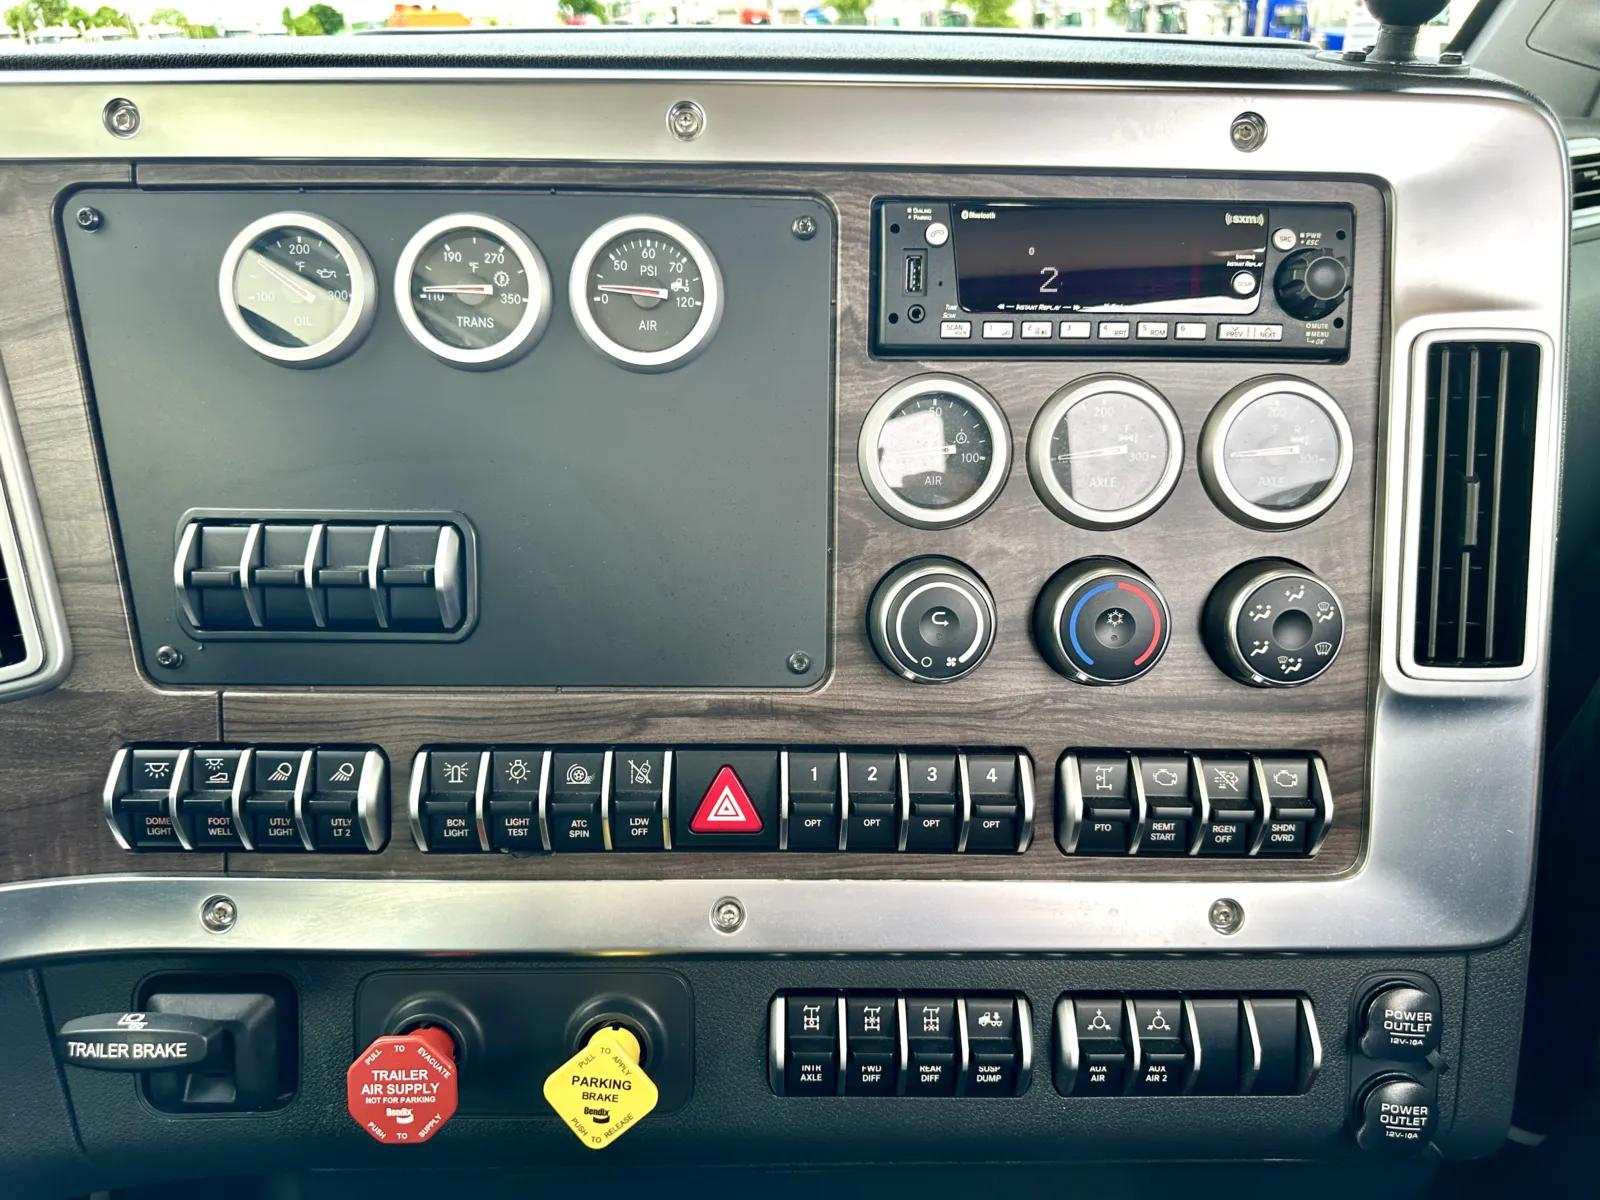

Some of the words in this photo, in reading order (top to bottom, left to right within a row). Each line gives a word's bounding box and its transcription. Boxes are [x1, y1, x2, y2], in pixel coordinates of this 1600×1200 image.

[969, 211, 996, 219] Bluetooth
[289, 244, 310, 255] 200
[641, 248, 656, 259] 60
[443, 252, 462, 263] 190
[484, 253, 505, 264] 270
[613, 260, 628, 271] 50
[669, 262, 683, 273] 70
[640, 265, 658, 277] PSI
[1039, 266, 1059, 293] 2
[328, 290, 348, 301] 300
[500, 294, 521, 305] 350
[601, 293, 609, 304] 0
[676, 297, 695, 308] 120
[294, 316, 312, 327] OIL
[456, 315, 494, 328] TRANS
[639, 320, 657, 331] AIR
[961, 452, 979, 463] 100
[1128, 451, 1149, 462] 300
[924, 475, 943, 486] AIR
[1089, 476, 1117, 488] AXLE
[810, 767, 817, 781] 1
[867, 766, 877, 781] 2
[927, 767, 938, 782] 3
[986, 768, 998, 783] 4
[145, 817, 171, 826] DOME
[208, 817, 230, 826] FOOT
[269, 818, 291, 826] UTLY
[331, 818, 352, 827] UTLY
[446, 818, 465, 827] BCN
[505, 818, 530, 826] LIGHT
[571, 819, 588, 828] ATC
[629, 818, 650, 826] LDW
[804, 819, 822, 827] OPT
[863, 818, 880, 827] OPT
[922, 819, 940, 828] OPT
[982, 820, 1000, 829] OPT
[1094, 824, 1112, 832] PTO
[1152, 822, 1176, 831] REMT
[1212, 825, 1236, 834] RGEN
[1271, 824, 1296, 832] SHDN
[146, 827, 172, 836] LIGHT
[208, 827, 232, 836] WELL
[269, 827, 294, 836] LIGHT
[333, 828, 344, 837] LT
[345, 829, 351, 837] 2
[444, 829, 469, 837] LIGHT
[507, 828, 528, 837] TEST
[569, 829, 590, 838] SPIN
[631, 827, 648, 836] OFF
[1150, 832, 1176, 841] START
[1214, 835, 1232, 843] OFF
[1271, 833, 1295, 842] OVRD
[1384, 1009, 1432, 1022] POWER
[1383, 1020, 1432, 1032] OUTLET
[68, 1041, 129, 1058] TRAILER
[133, 1042, 188, 1058] BRAKE
[365, 1049, 382, 1066] PULL
[394, 1044, 405, 1053] TO
[417, 1047, 451, 1079] EVACUATE
[578, 1054, 597, 1069] PULL
[600, 1047, 611, 1055] TO
[612, 1055, 632, 1077] APPLY
[861, 1065, 882, 1073] FWD
[919, 1065, 942, 1073] REAR
[978, 1065, 1001, 1073] SUSP
[1089, 1065, 1107, 1073] AUX
[1148, 1065, 1166, 1073] AUX
[371, 1069, 429, 1081] TRAILER
[800, 1073, 823, 1082] AXLE
[862, 1074, 881, 1082] DIFF
[921, 1074, 940, 1082] DIFF
[976, 1074, 1002, 1083] DUMP
[1090, 1074, 1105, 1082] AIR
[1145, 1074, 1160, 1082] AIR
[1162, 1074, 1168, 1082] 2
[571, 1075, 632, 1091] PARKING
[361, 1084, 384, 1095] AIR
[386, 1082, 440, 1095] SUPPLY
[365, 1097, 381, 1105] NOT
[383, 1096, 399, 1104] FOR
[400, 1095, 436, 1104] PARKING
[581, 1091, 619, 1103] BRAKE
[386, 1107, 413, 1117] Bendix
[584, 1106, 610, 1117] Bendix
[1381, 1103, 1429, 1116] POWER
[1379, 1114, 1427, 1126] OUTLET
[367, 1121, 387, 1139] PUSH
[396, 1132, 408, 1140] TO
[418, 1112, 442, 1138] SUPPLY
[571, 1117, 589, 1137] PUSH
[591, 1136, 602, 1144] TO
[603, 1112, 634, 1139] RELEASE
